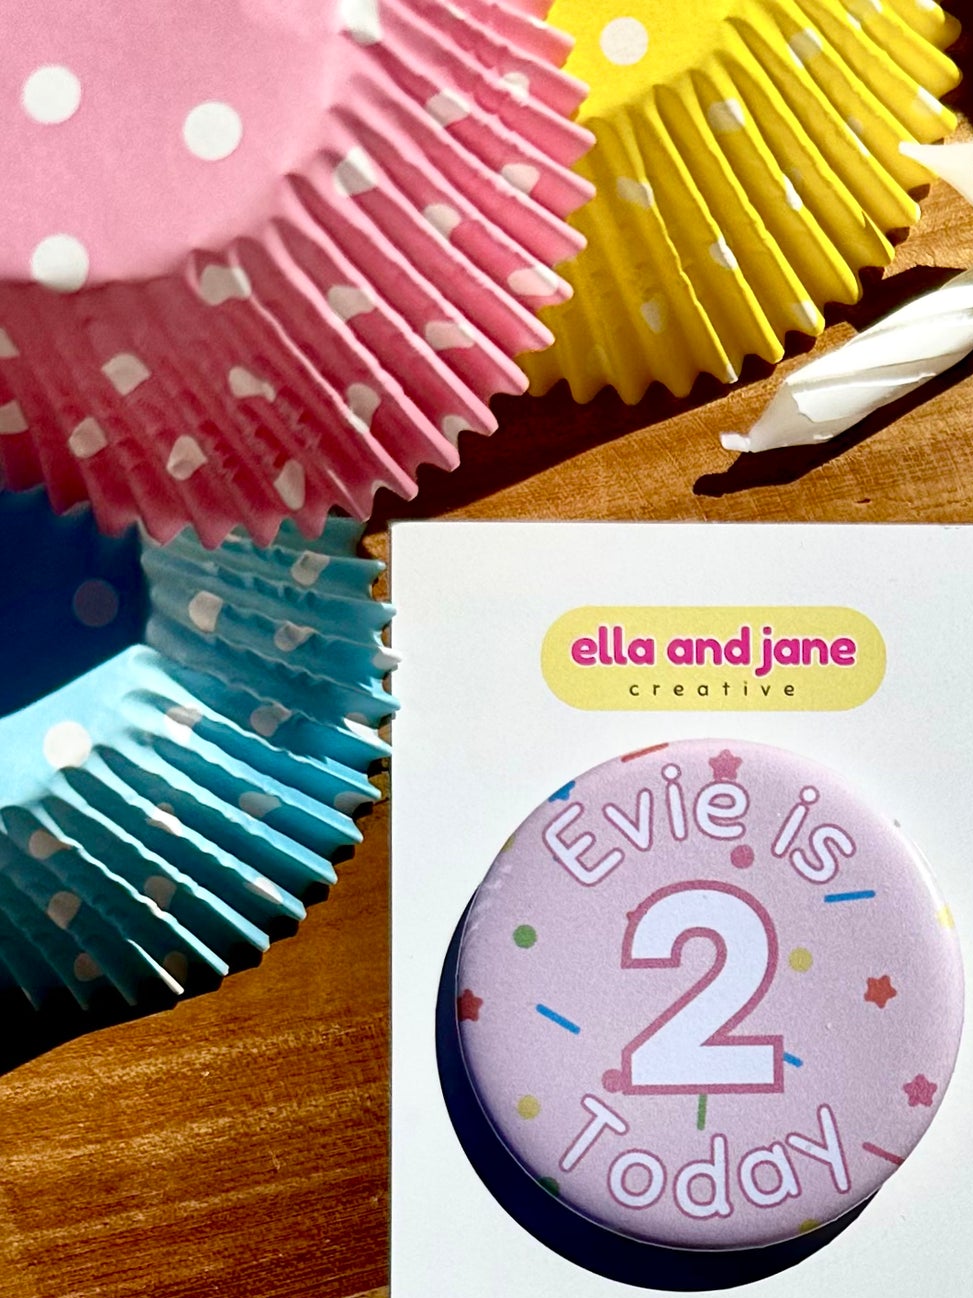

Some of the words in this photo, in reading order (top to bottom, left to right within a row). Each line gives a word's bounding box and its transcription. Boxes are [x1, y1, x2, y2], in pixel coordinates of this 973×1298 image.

[570, 626, 654, 666] ella
[666, 626, 750, 666] and
[754, 626, 856, 677] jane
[629, 680, 796, 697] creative
[542, 763, 750, 887] Evie
[771, 786, 856, 884] is
[621, 880, 784, 1095] 2
[559, 1094, 851, 1220] Today
